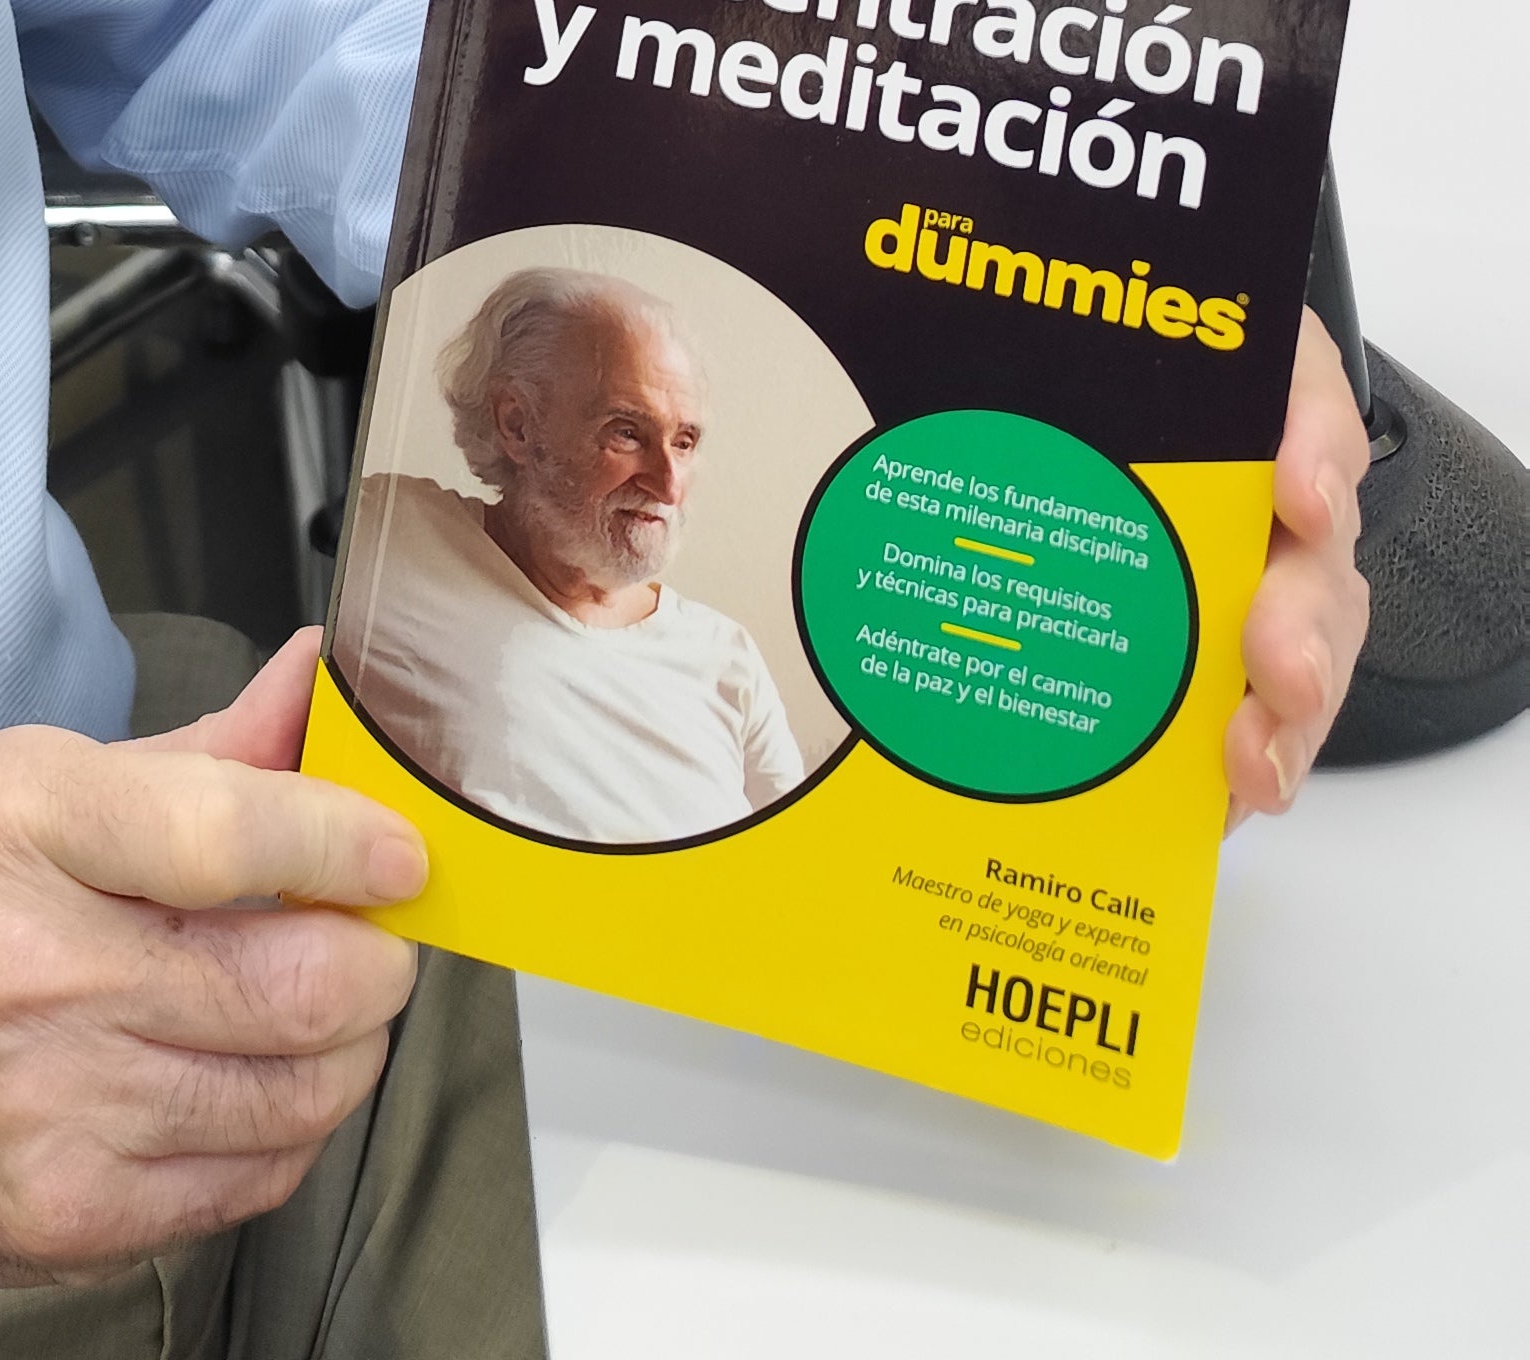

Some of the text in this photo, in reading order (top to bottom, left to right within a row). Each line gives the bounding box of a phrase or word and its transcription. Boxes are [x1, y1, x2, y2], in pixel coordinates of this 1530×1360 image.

[615, 14, 1207, 210] meditación
[923, 208, 974, 234] para
[865, 480, 1149, 570] de esta milenaria disciplina
[872, 454, 1149, 541] Aprende los fundamentos
[856, 568, 1129, 654] y técnicas para practicarla
[883, 542, 1112, 620] Domina los requisitos
[855, 624, 1112, 709] Adéntrate por el camino
[860, 654, 1100, 735] de la paz y el bienestar
[892, 865, 1151, 956] Maestro de yoga y experto
[985, 857, 1156, 926] Ramiro Calle
[938, 913, 1149, 987] en psicología oriental
[965, 963, 1140, 1057] HOEPLI
[961, 1021, 1133, 1090] ediciones
